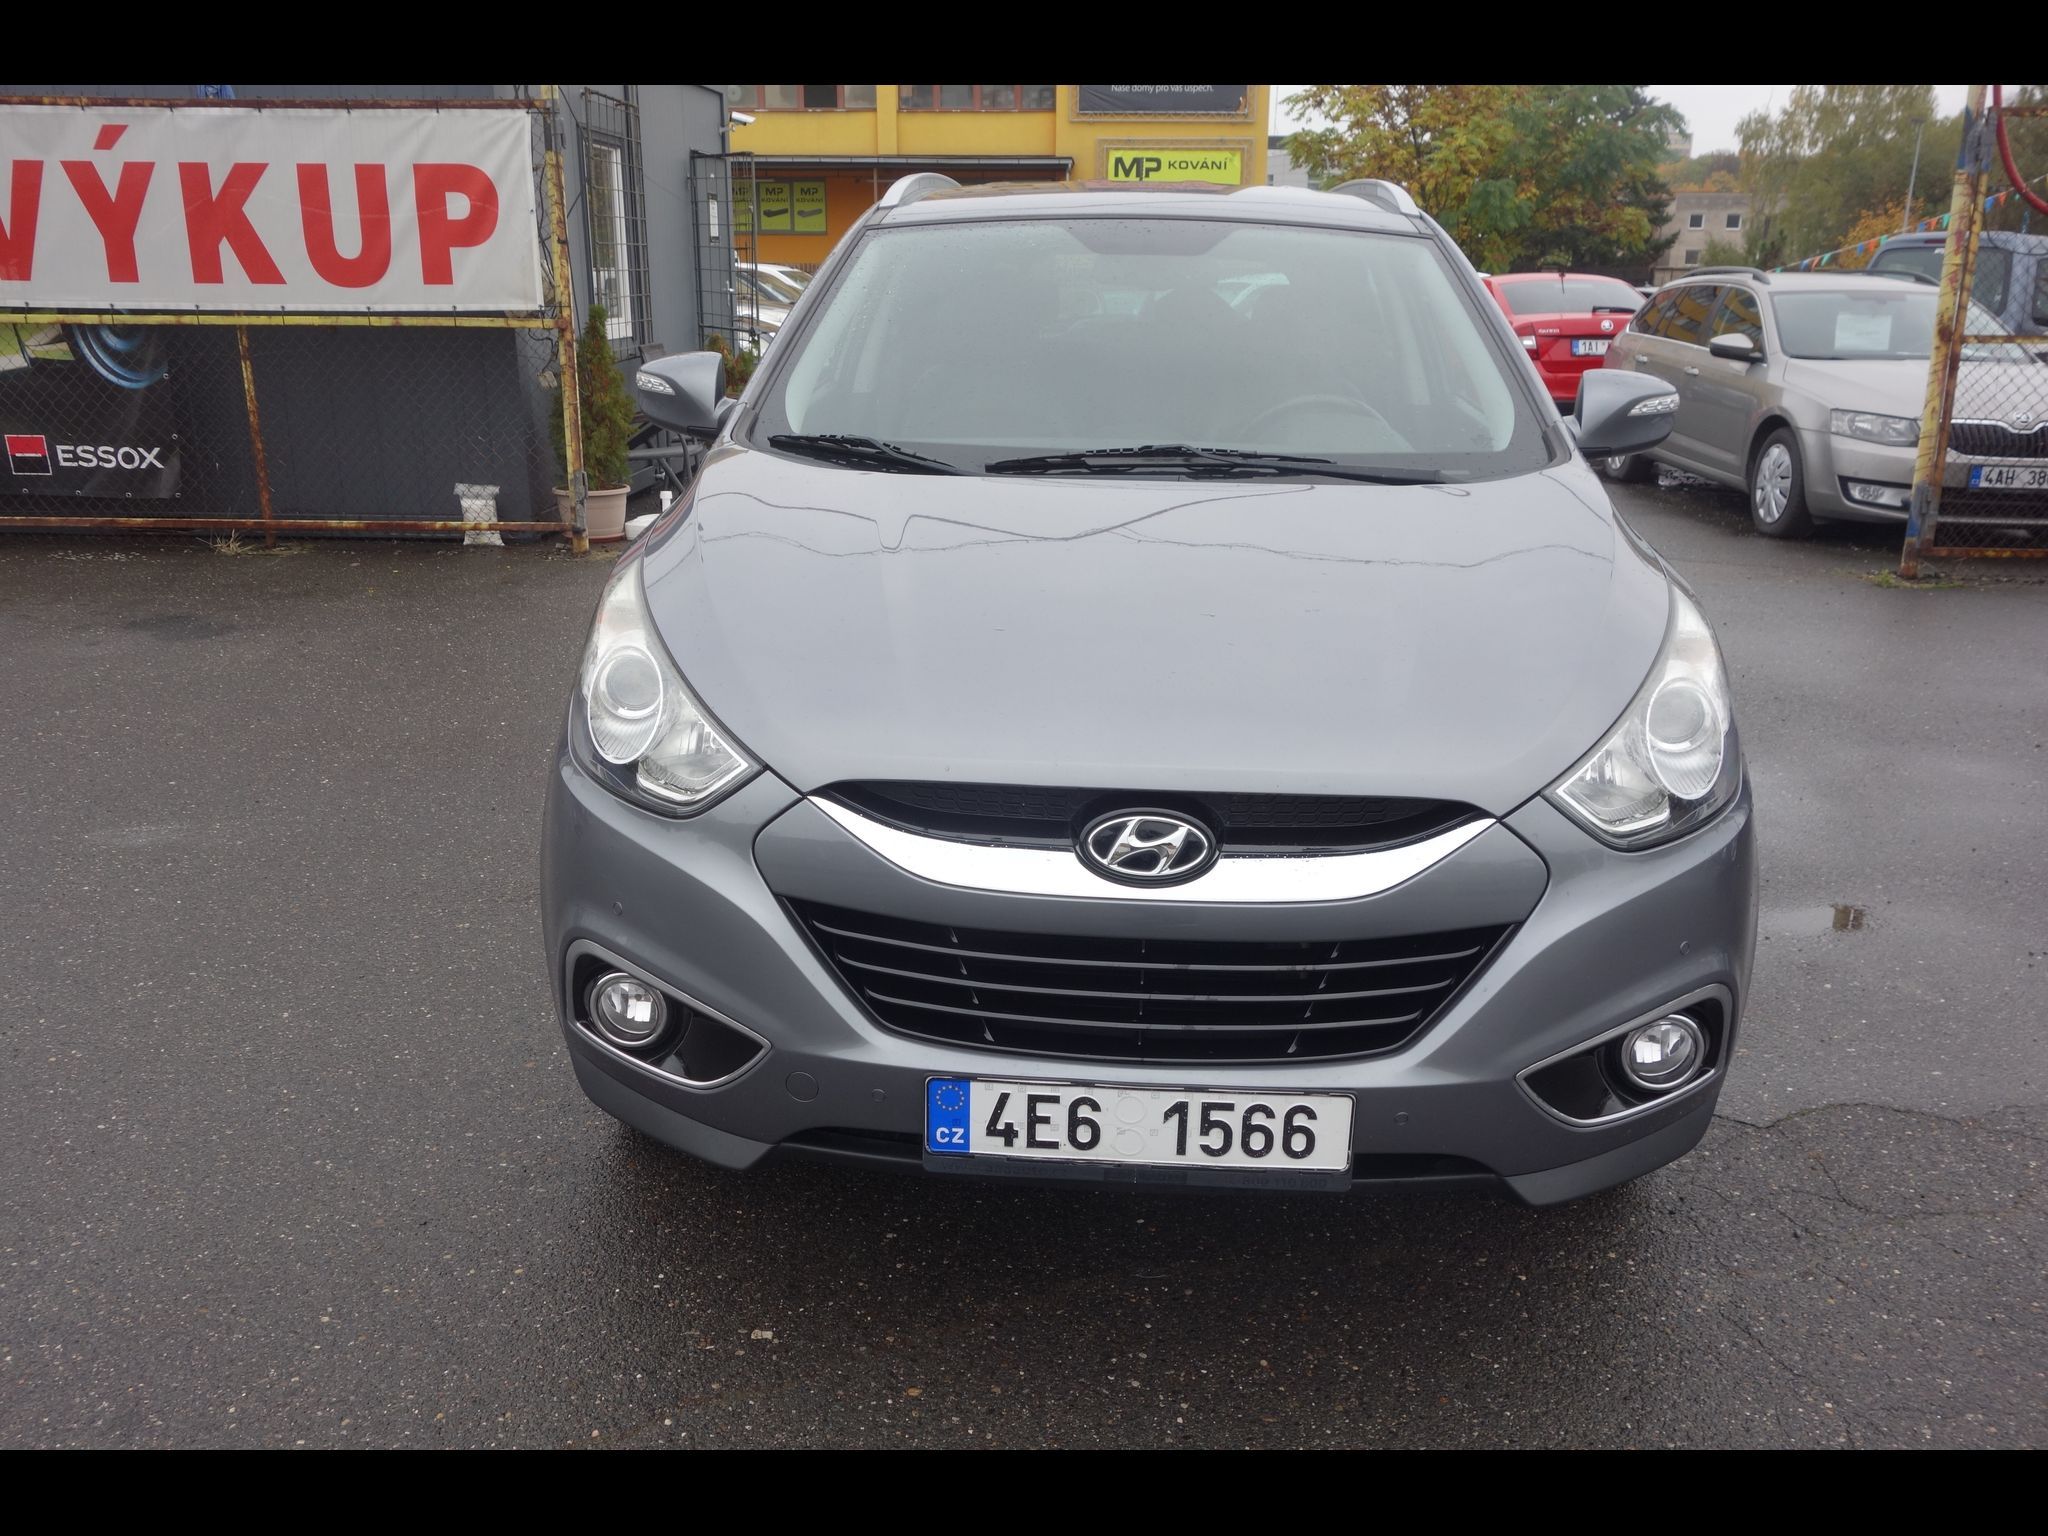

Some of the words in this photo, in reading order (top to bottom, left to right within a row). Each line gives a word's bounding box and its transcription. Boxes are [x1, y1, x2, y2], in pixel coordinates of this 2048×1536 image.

[1113, 157, 1162, 180] MP
[1168, 158, 1228, 170] KOVÁNÍ
[765, 187, 784, 196] MP
[800, 187, 819, 196] MP
[55, 445, 165, 470] ESSOX
[936, 1127, 965, 1144] CZ
[985, 1091, 1102, 1152] 4E6
[1162, 1100, 1318, 1160] 1566
